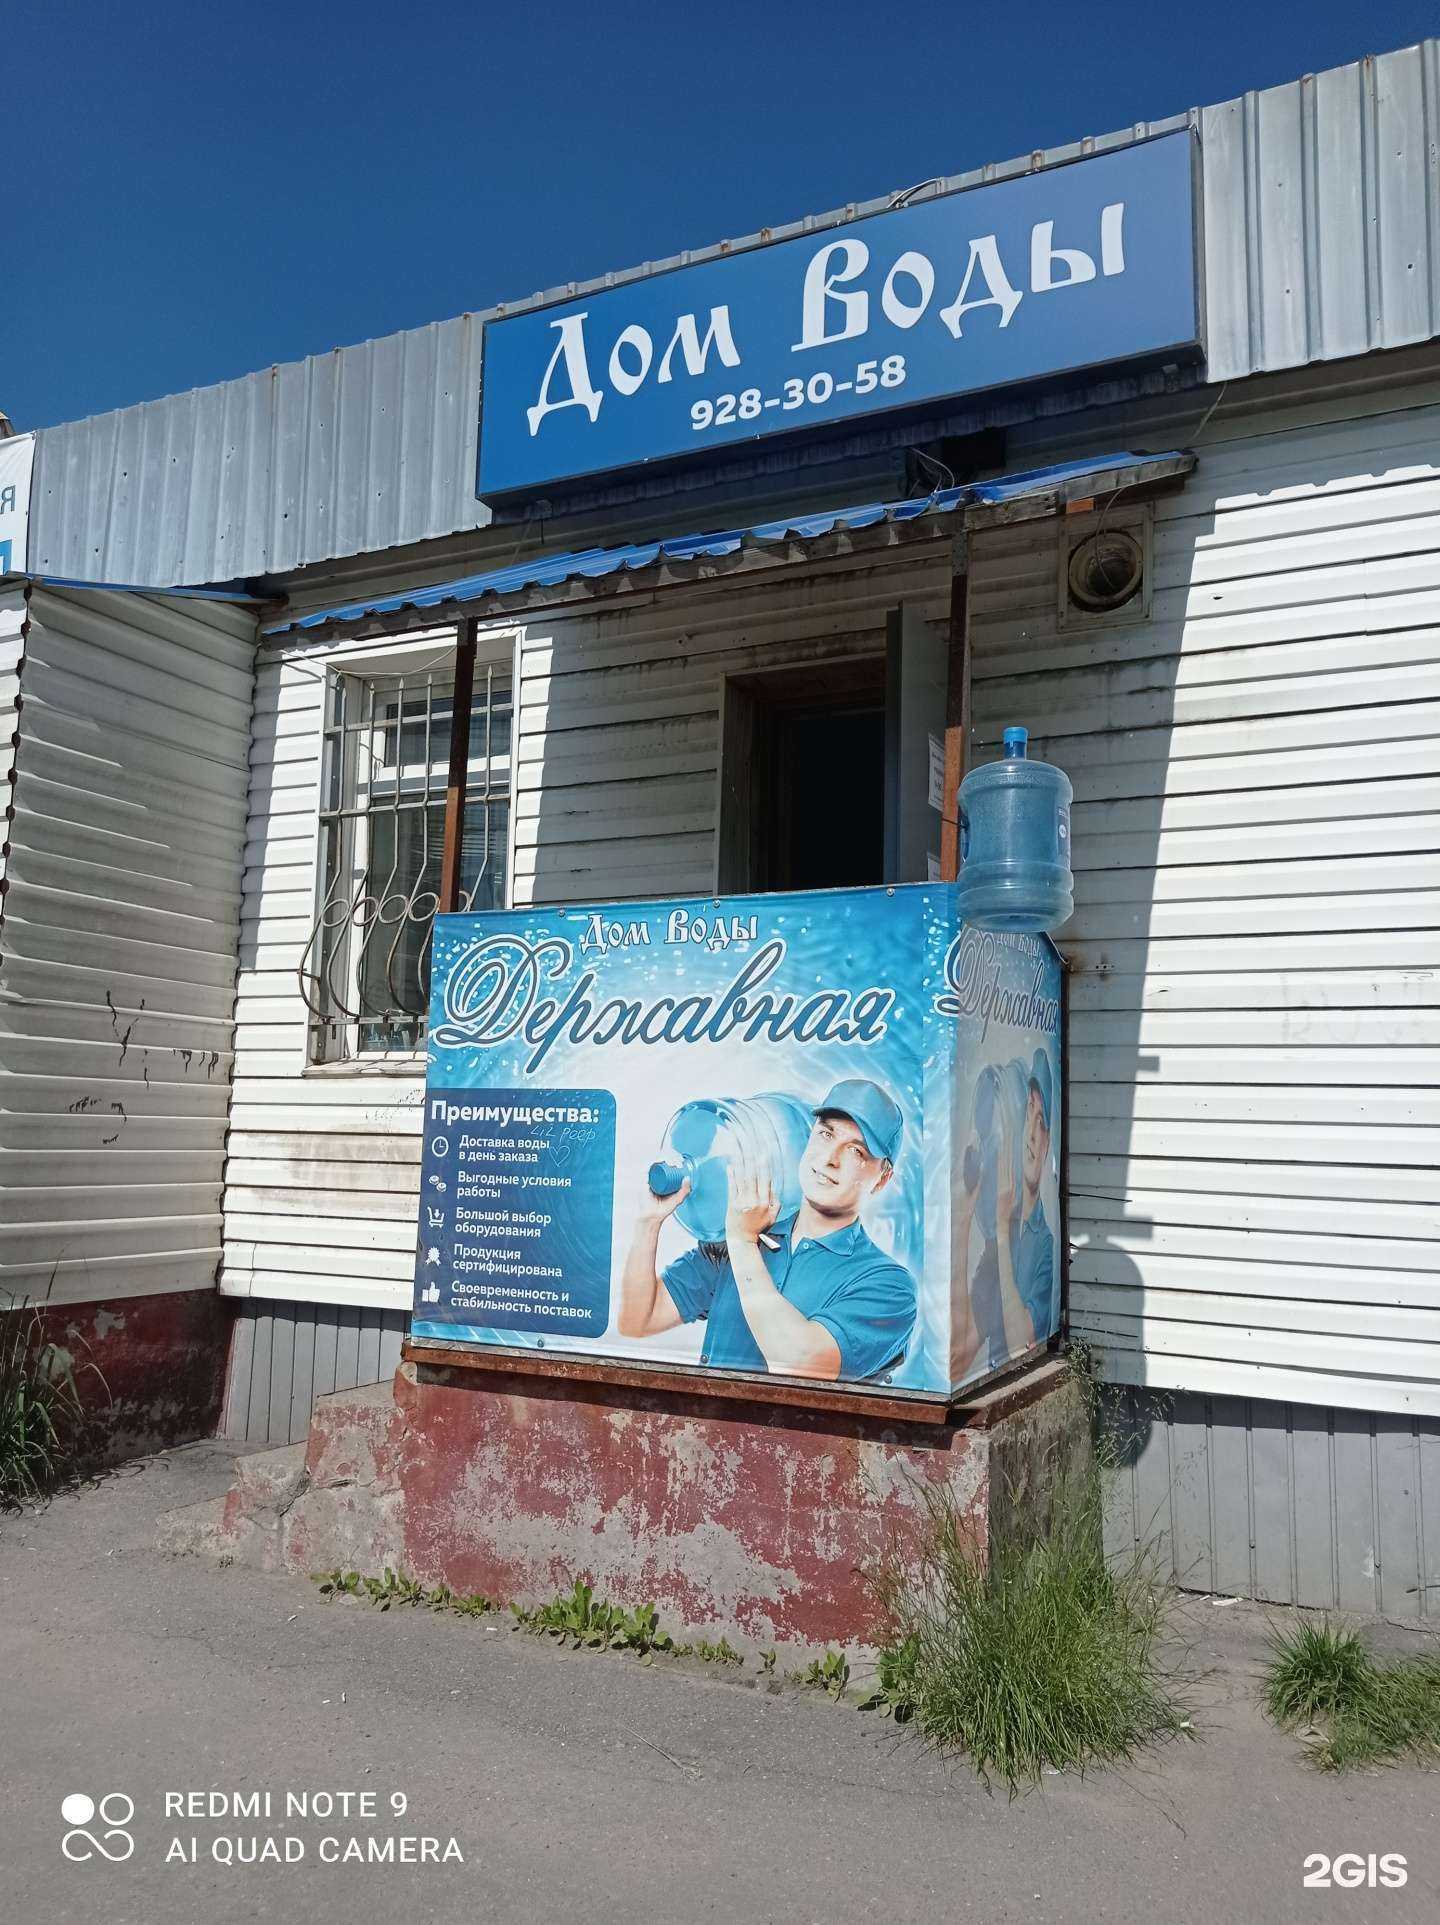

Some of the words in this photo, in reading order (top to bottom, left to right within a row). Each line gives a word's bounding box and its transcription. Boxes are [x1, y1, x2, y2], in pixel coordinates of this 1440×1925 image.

[526, 304, 741, 437] Дом
[790, 202, 1125, 353] Воды
[690, 354, 907, 431] 928-30-58
[581, 913, 651, 955] Дом
[664, 907, 759, 951] Воды
[432, 933, 896, 1076] Державная
[431, 1100, 600, 1127] Преимущества:
[459, 1135, 515, 1149] Доставка
[518, 1138, 551, 1150] воды
[459, 1151, 465, 1160] в
[467, 1151, 496, 1163] день
[498, 1153, 538, 1163] заказа
[458, 1171, 519, 1186] Выгодные
[521, 1176, 572, 1188] условия
[457, 1187, 501, 1200] работы
[456, 1207, 509, 1222] Большой
[511, 1212, 552, 1225] выбор
[455, 1223, 541, 1238] оборудования
[454, 1244, 521, 1260] Продукция
[453, 1260, 563, 1278] сертифицирована
[451, 1281, 558, 1301] Своевременность
[561, 1292, 570, 1302] и
[450, 1297, 532, 1313] стабильность
[534, 1305, 592, 1319] поставок
